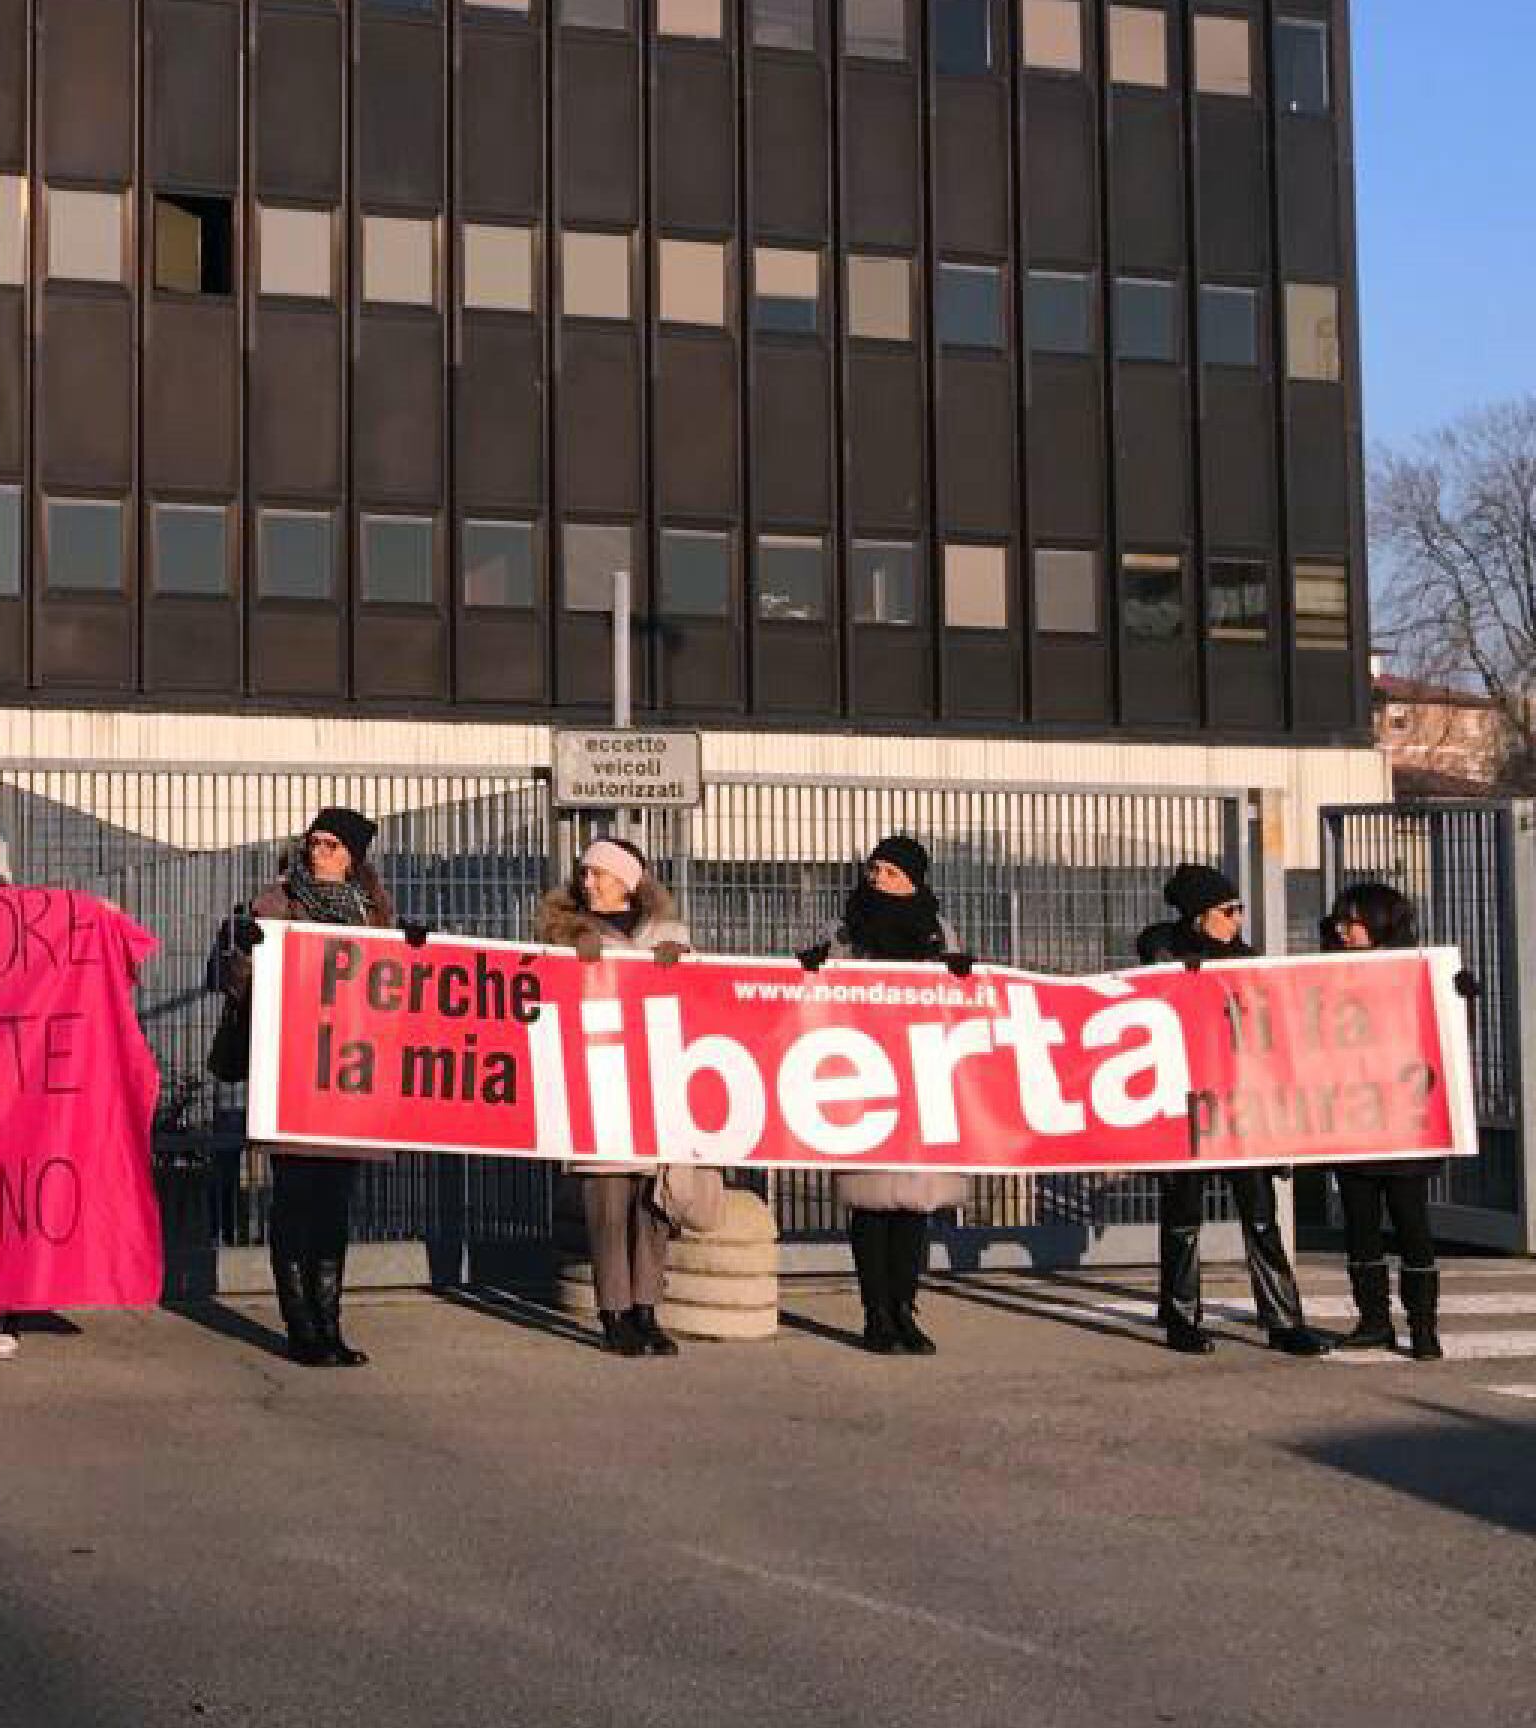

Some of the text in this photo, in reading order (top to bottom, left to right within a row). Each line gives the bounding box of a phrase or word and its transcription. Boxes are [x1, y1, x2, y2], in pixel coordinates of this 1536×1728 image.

[585, 737, 667, 753] eccetto
[592, 758, 661, 776] veicoli
[572, 780, 685, 798] autorizzati
[321, 937, 542, 1025] Perché
[734, 980, 998, 1009] www.nondasola.it
[1223, 984, 1376, 1055] ti fa
[317, 1021, 518, 1106] la mia
[527, 976, 1192, 1164] libertà
[1185, 1061, 1436, 1158] paura?
